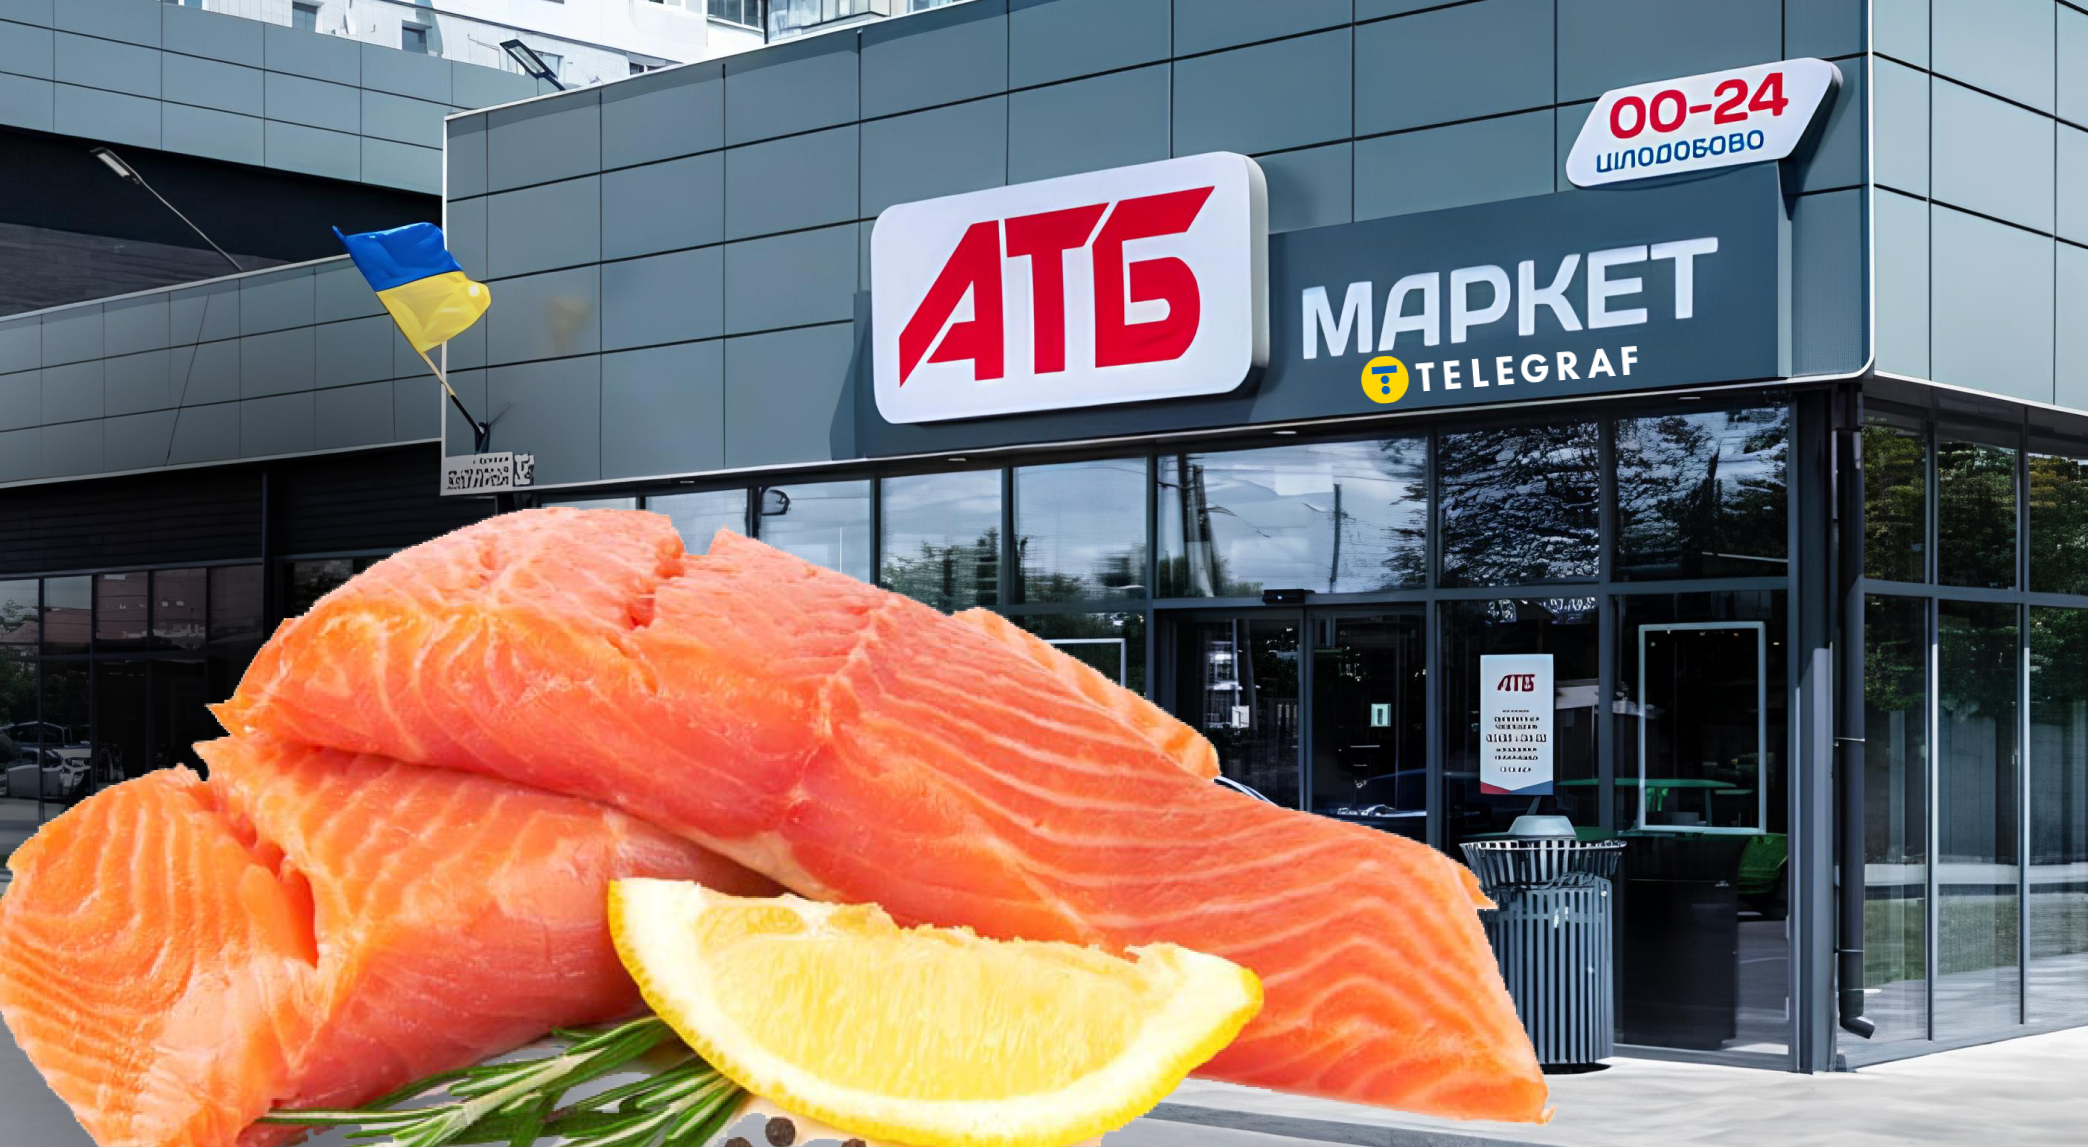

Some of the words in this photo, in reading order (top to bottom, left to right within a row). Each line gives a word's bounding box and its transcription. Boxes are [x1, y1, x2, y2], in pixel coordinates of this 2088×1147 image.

[1609, 72, 1789, 139] 00-24
[898, 185, 1216, 389] АТБ
[1302, 236, 1719, 360] МАРКЕТ
